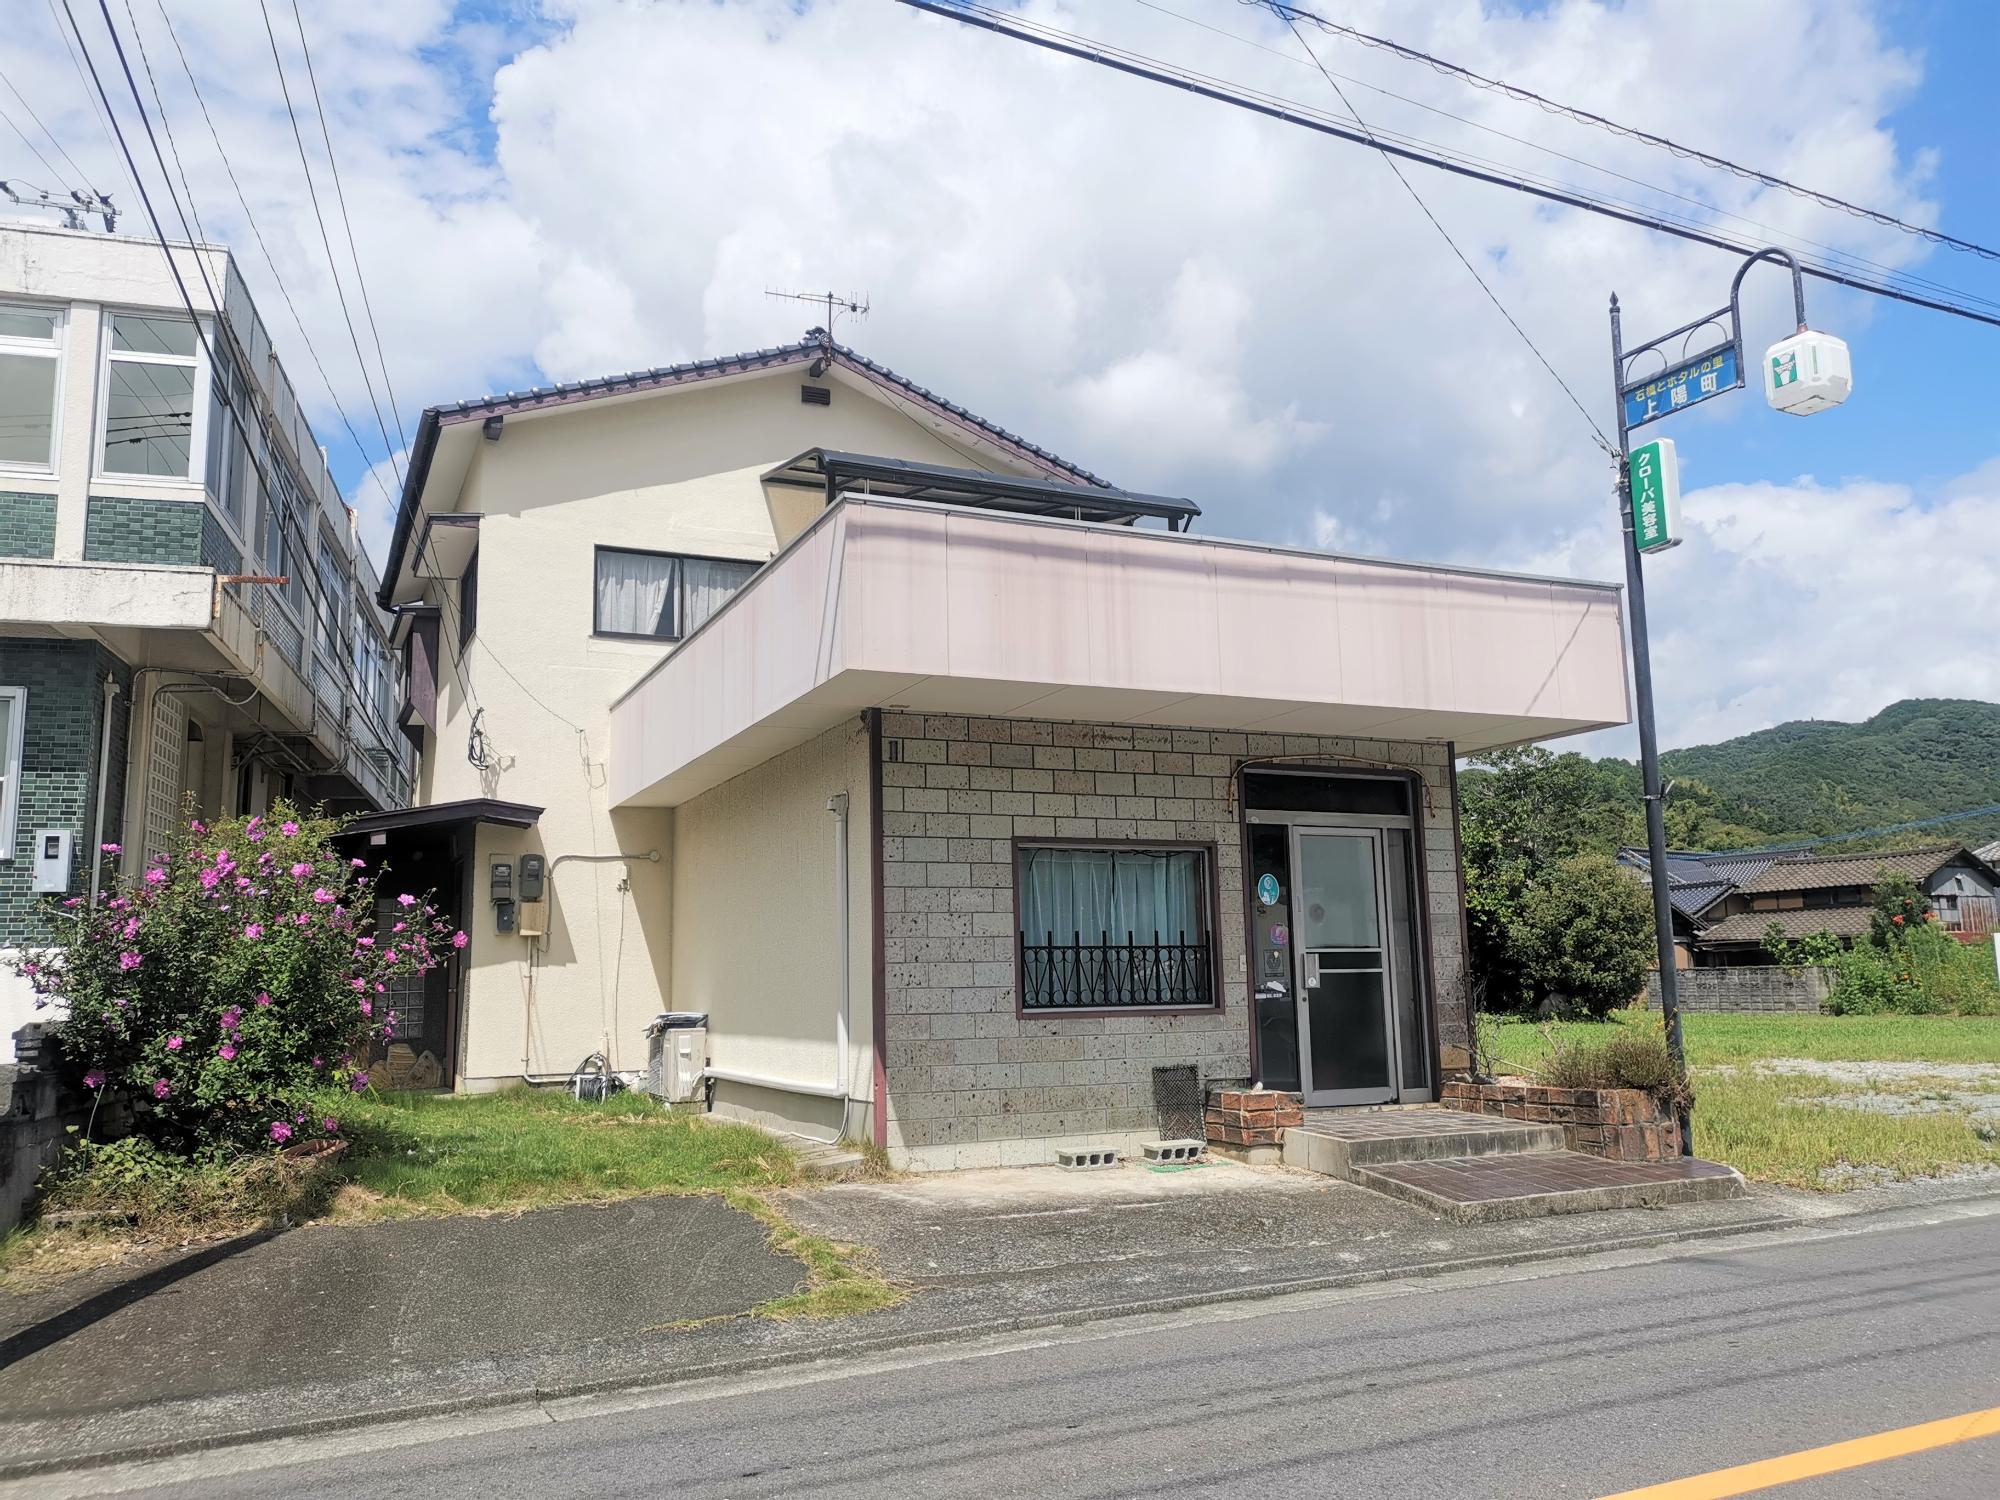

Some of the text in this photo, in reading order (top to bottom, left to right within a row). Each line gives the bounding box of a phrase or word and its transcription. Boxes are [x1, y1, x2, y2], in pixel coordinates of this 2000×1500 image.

[1642, 372, 1718, 420] 上陽町
[1639, 453, 1659, 540] クローバ美容室
